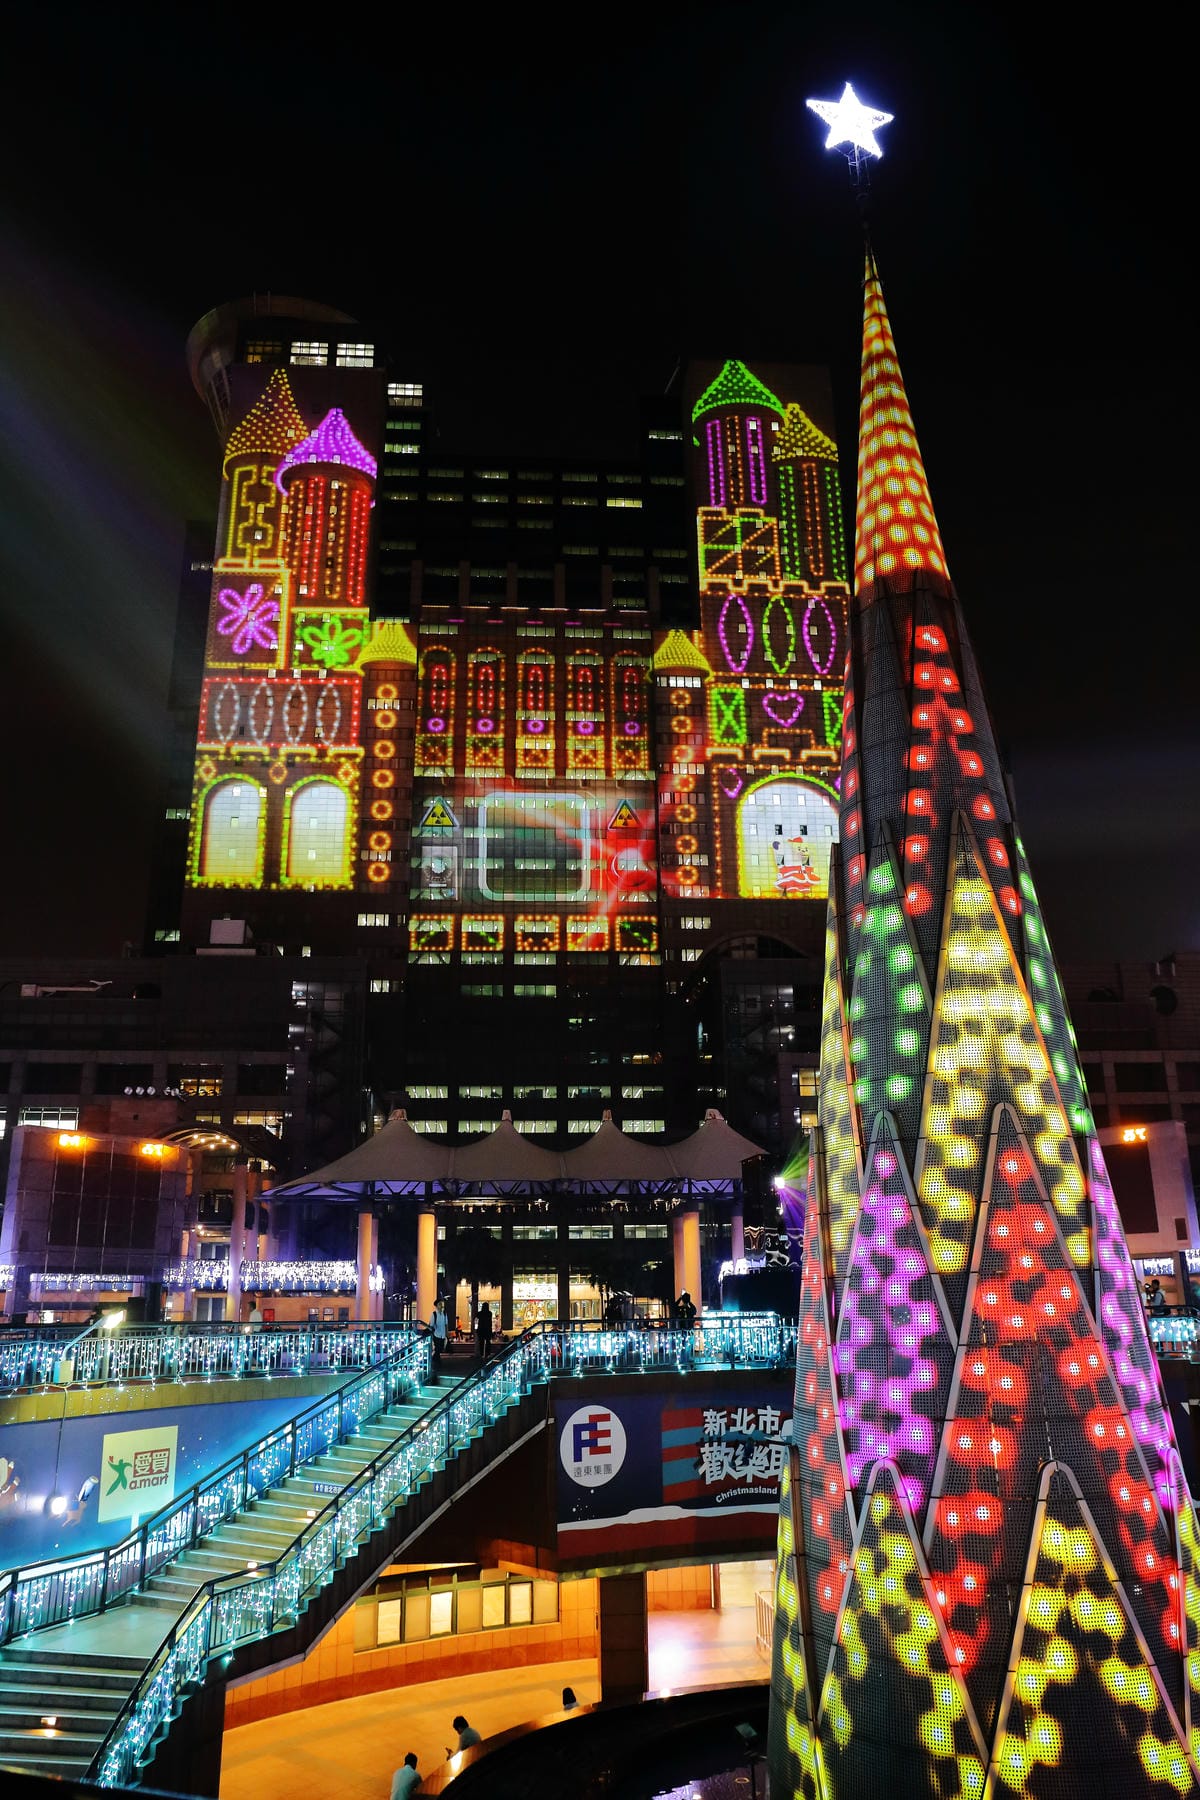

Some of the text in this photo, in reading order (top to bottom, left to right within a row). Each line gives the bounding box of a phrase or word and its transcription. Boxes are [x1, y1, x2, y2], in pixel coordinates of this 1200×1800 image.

[703, 1405, 781, 1436] 新北市
[573, 1464, 613, 1478] 遠東集團
[129, 1474, 169, 1490] a.mart
[715, 1485, 778, 1503] Christmasland
